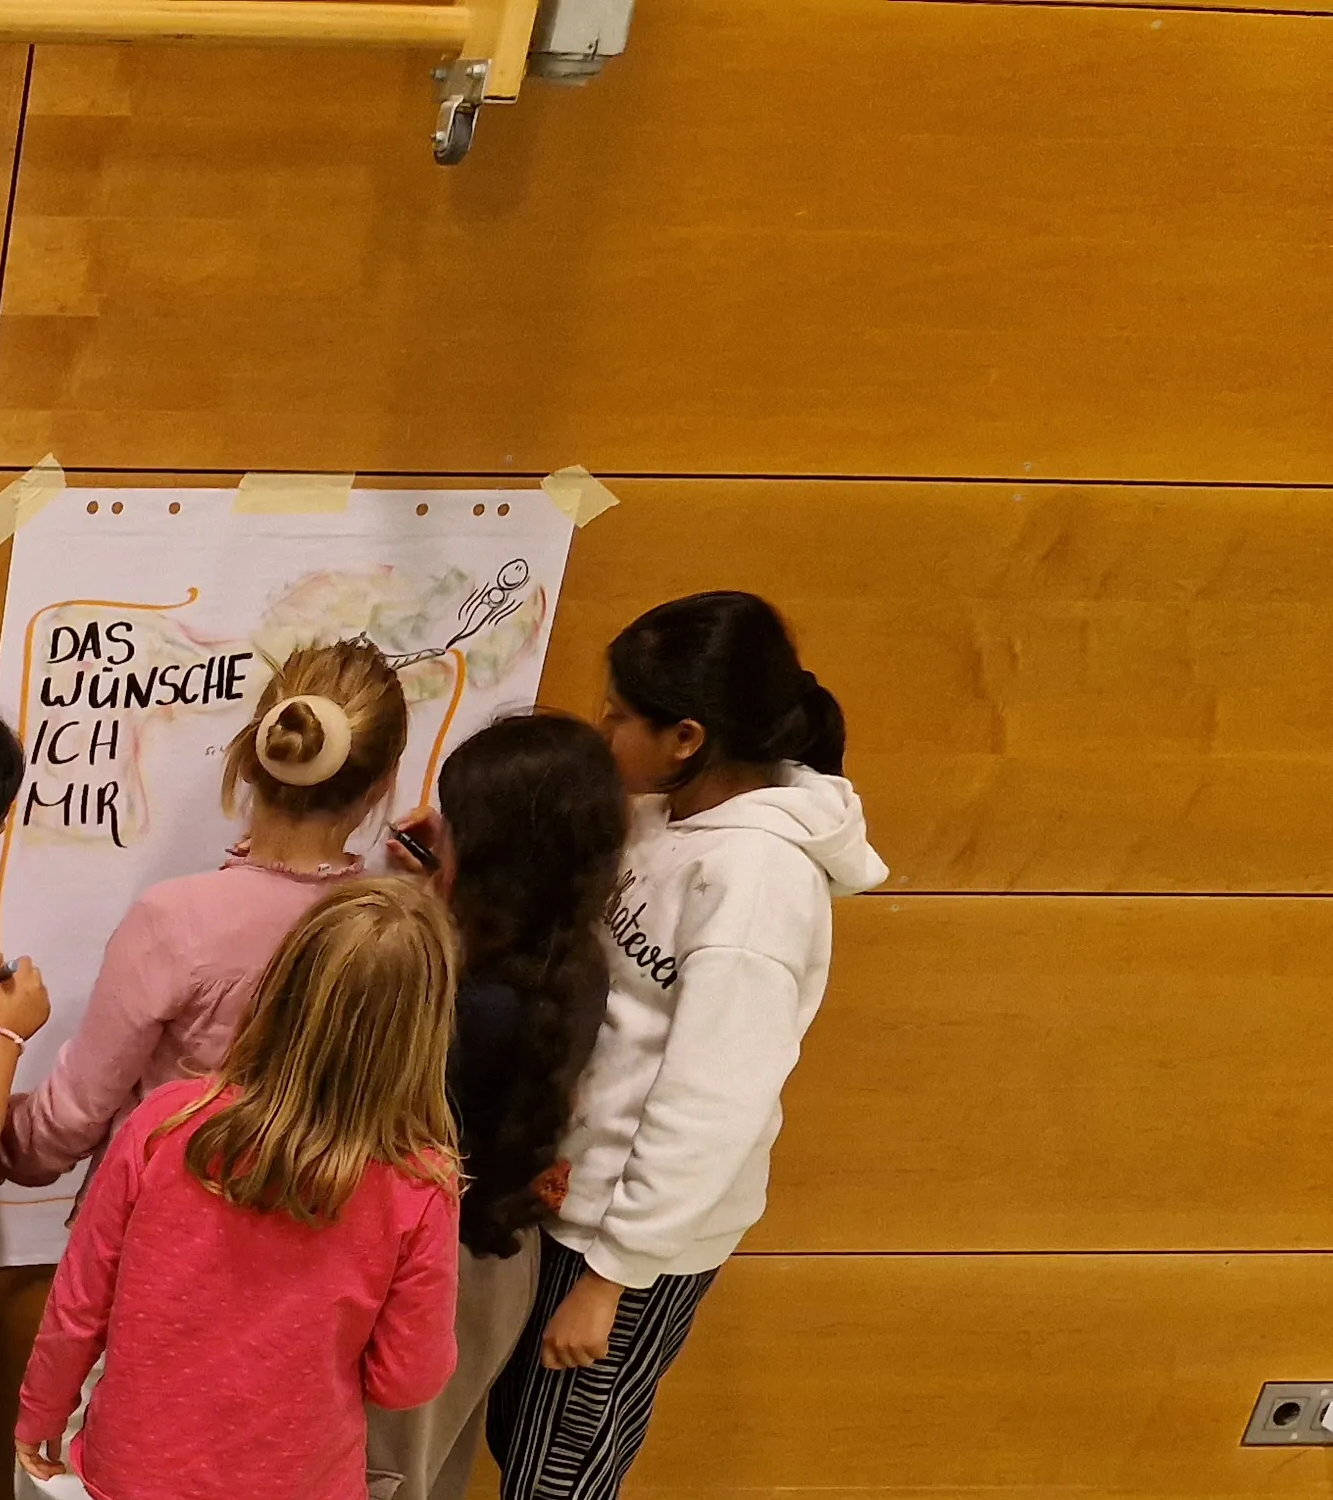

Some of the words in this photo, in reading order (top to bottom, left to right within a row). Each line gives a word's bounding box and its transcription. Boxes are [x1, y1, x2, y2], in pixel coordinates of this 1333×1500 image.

[47, 621, 135, 665] DAS
[30, 719, 119, 766] ICH
[22, 780, 127, 848] MIR
